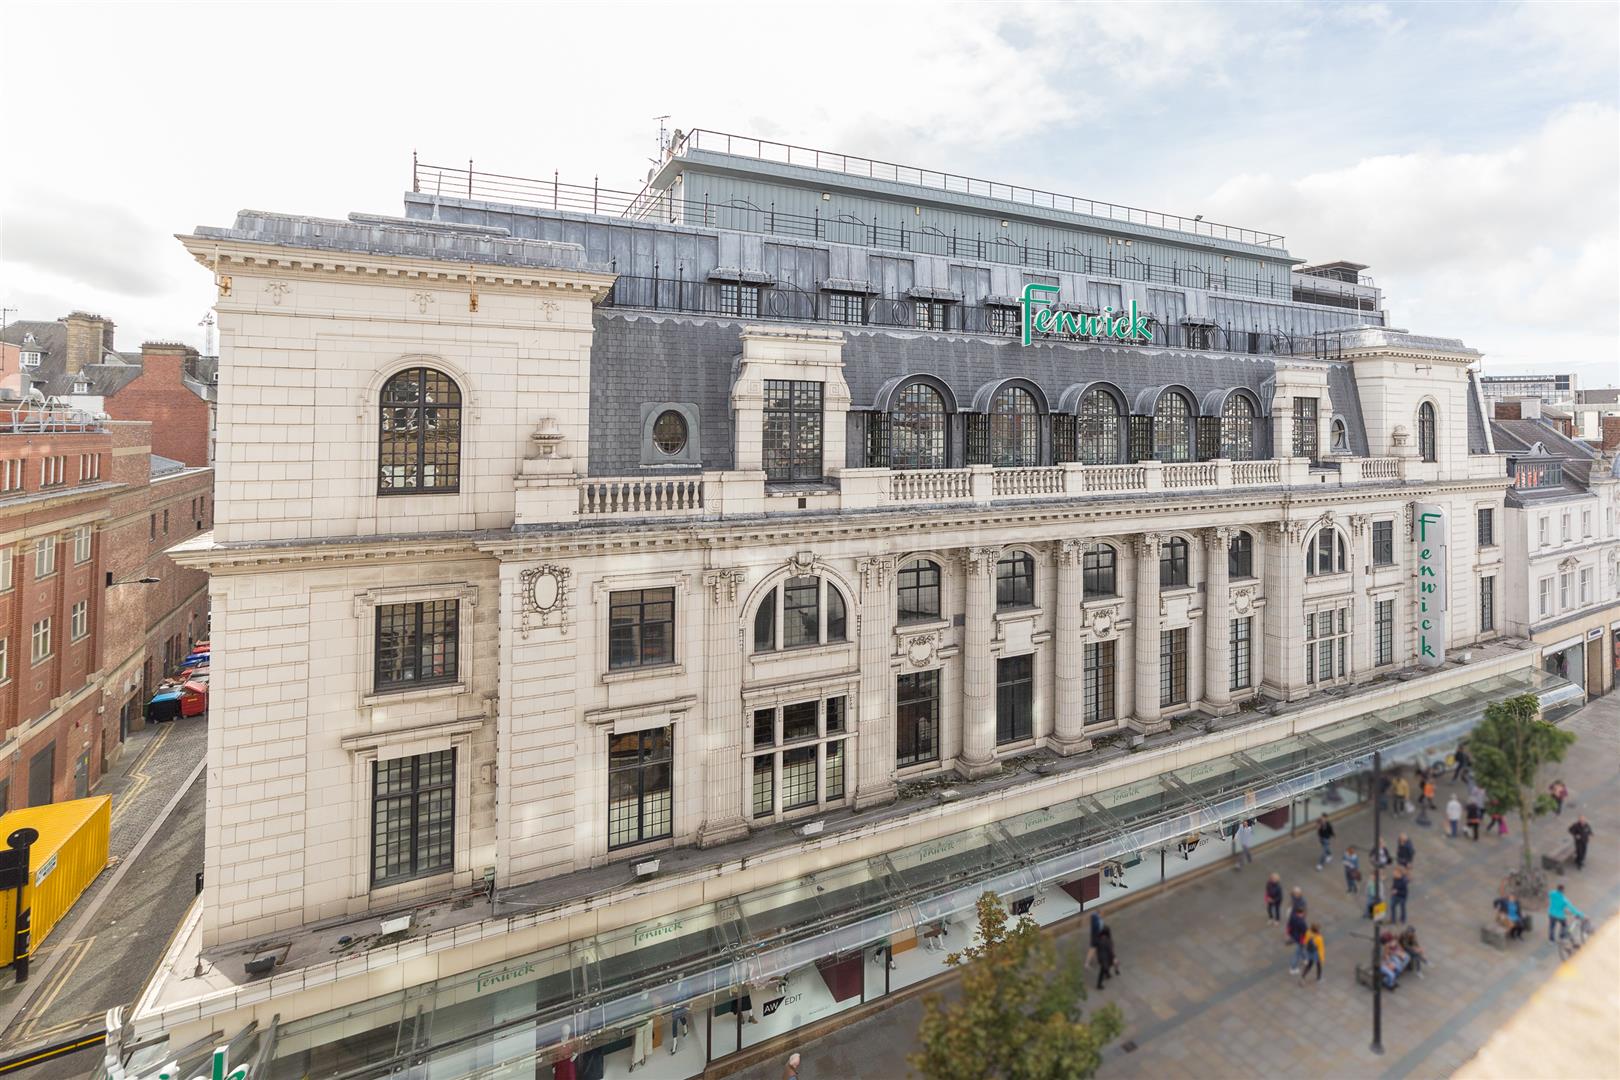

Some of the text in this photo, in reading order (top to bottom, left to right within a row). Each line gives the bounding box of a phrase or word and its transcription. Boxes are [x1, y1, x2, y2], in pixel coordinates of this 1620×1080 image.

[1016, 283, 1153, 347] Fenwick
[1418, 513, 1442, 658] Fenwick
[632, 919, 683, 946] Fenwick
[476, 961, 535, 992] Fenwick
[764, 993, 802, 1014] AW EDIT
